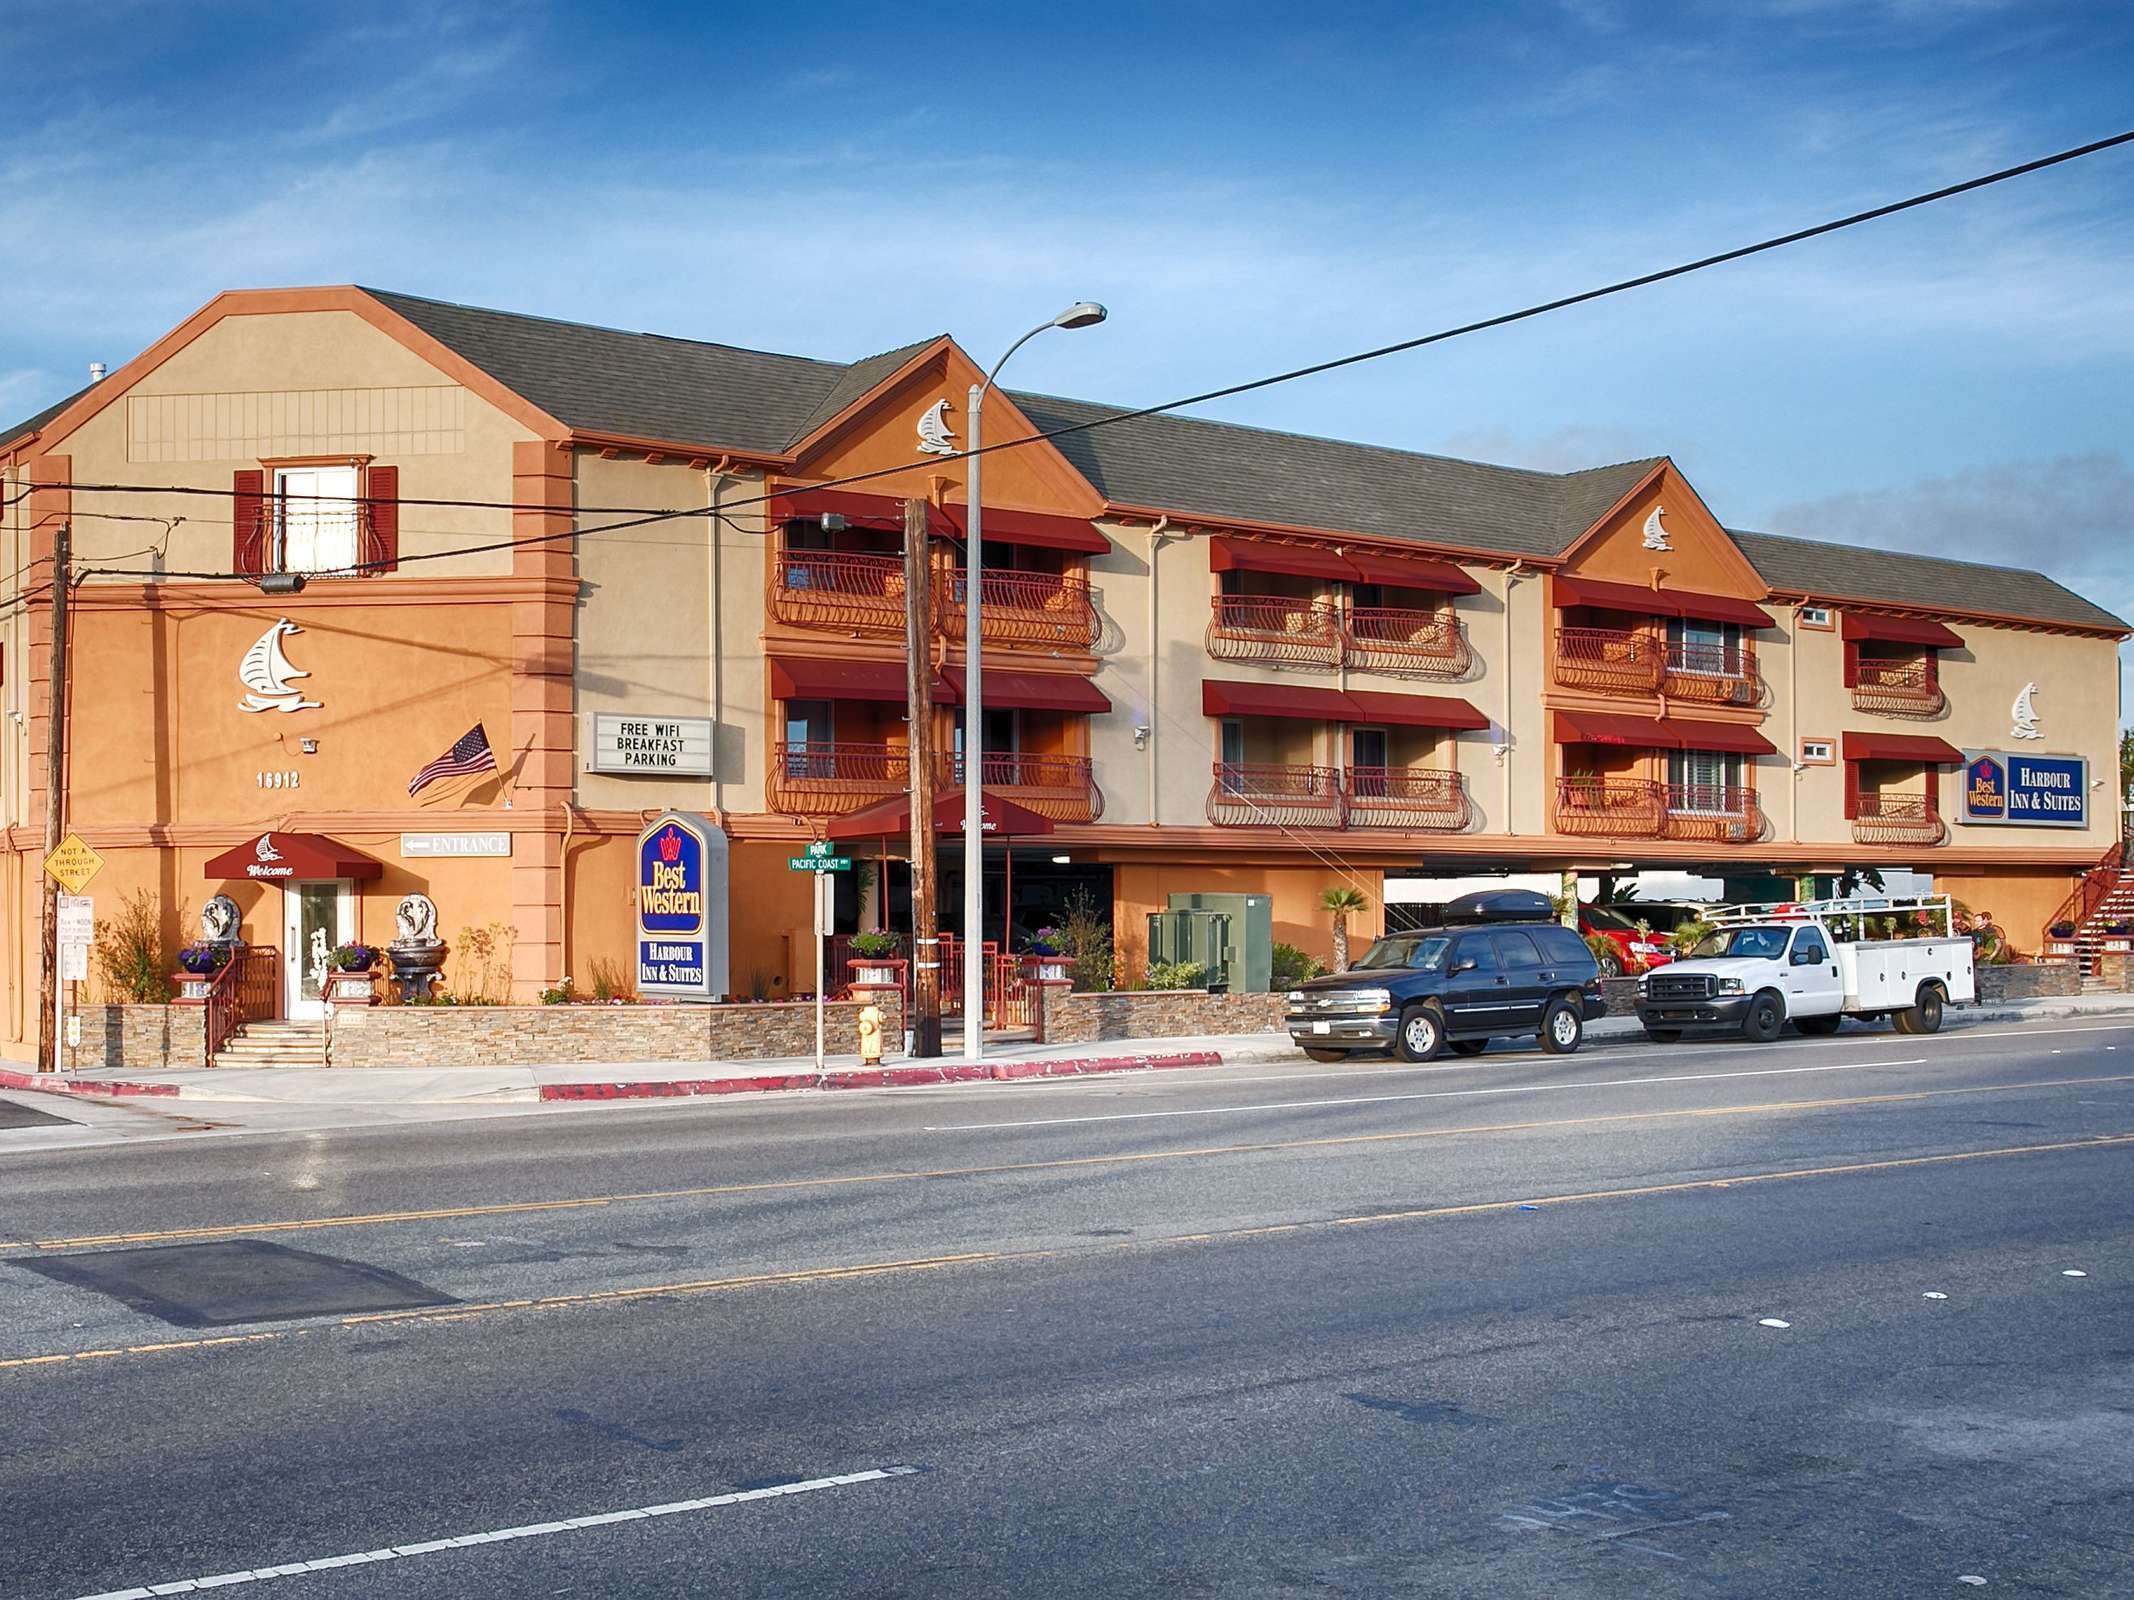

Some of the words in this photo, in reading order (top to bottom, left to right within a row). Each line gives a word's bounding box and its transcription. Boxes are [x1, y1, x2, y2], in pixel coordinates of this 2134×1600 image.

[620, 722, 649, 736] FREE
[655, 723, 680, 737] WIFI
[617, 737, 685, 752] BREAKFAST
[625, 752, 676, 767] PARKING
[256, 770, 300, 789] 16912
[1976, 777, 1996, 794] Best
[1968, 790, 2003, 808] Western
[2031, 792, 2041, 810] &
[60, 847, 77, 855] NOT
[81, 847, 87, 855] A
[431, 837, 507, 853] ENTRANCE
[54, 857, 95, 867] THROUGH
[791, 858, 817, 870] PACIFIC
[818, 858, 839, 870] COAST
[60, 868, 91, 877] STREET
[246, 865, 294, 877] Welcome
[653, 860, 686, 890] Best
[641, 885, 701, 914] Western
[659, 964, 668, 982] &
